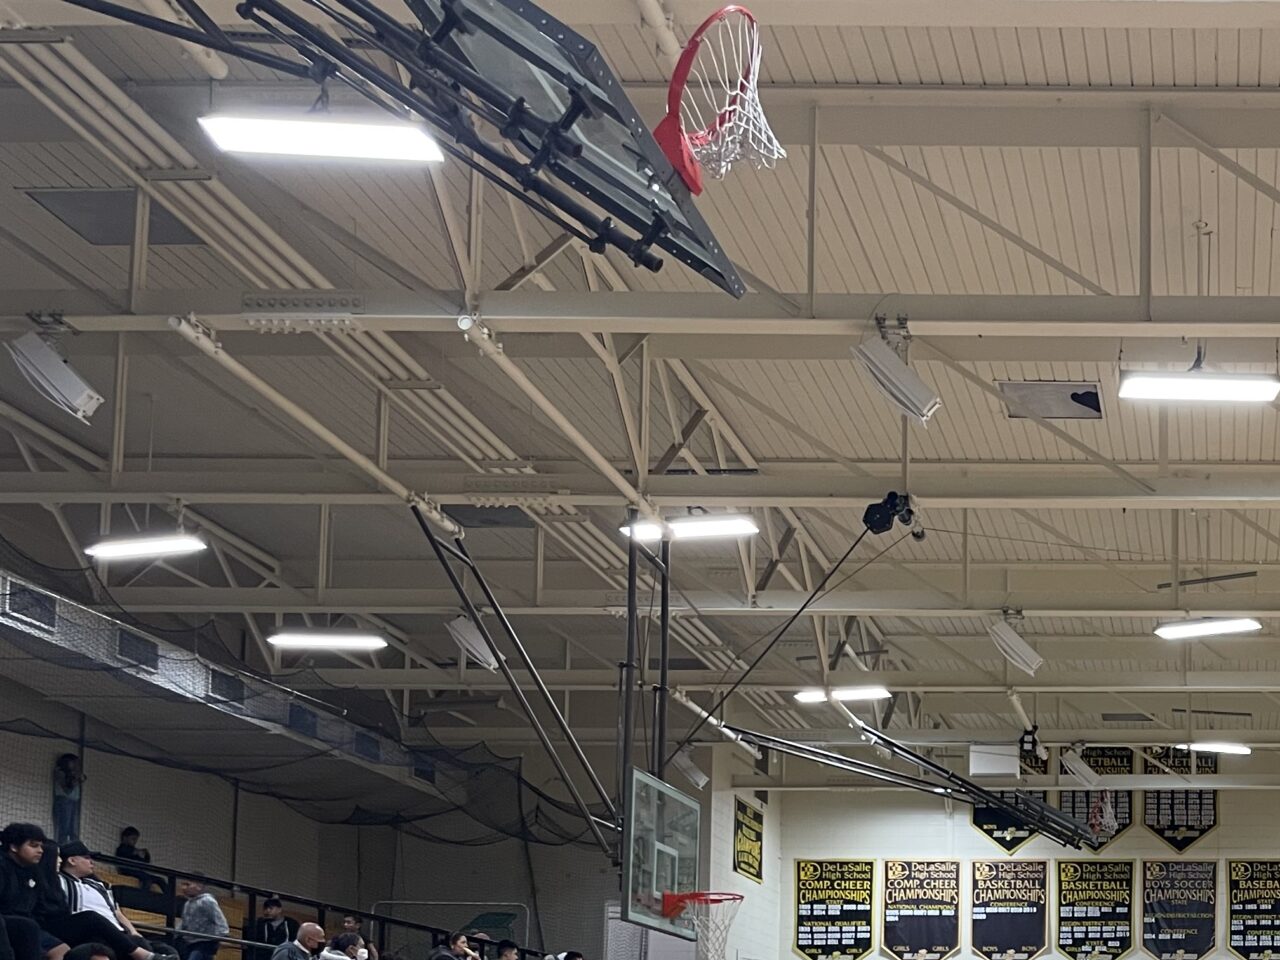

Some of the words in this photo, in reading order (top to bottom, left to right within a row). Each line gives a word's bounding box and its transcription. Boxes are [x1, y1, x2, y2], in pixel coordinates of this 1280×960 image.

[823, 863, 871, 871] DeLaSalle
[911, 863, 957, 871] DeLaSalle
[998, 863, 1044, 871] DeLaSalle
[1083, 864, 1130, 872] DeLaSalle
[823, 872, 841, 880] High
[911, 871, 929, 880] High
[998, 872, 1016, 880] High
[1083, 873, 1101, 881] High
[1253, 872, 1271, 880] High
[799, 881, 832, 889] COMP.
[834, 881, 871, 889] CHEER
[888, 880, 921, 888] COMP.
[924, 880, 957, 888] CHEER
[978, 880, 1041, 888] BASKETBALL
[1062, 881, 1129, 889] BASKETBALL
[1146, 880, 1170, 888] BOYS
[1174, 880, 1213, 888] SOCCER
[800, 890, 870, 904] CHAMPIONSHIPS
[886, 889, 958, 904] CHAMPIONSHIPS
[974, 889, 1045, 904] CHAMPIONSHIPS
[1061, 891, 1130, 904] CHAMPIONSHIPS
[1144, 889, 1214, 904] CHAMPIONSHIPS
